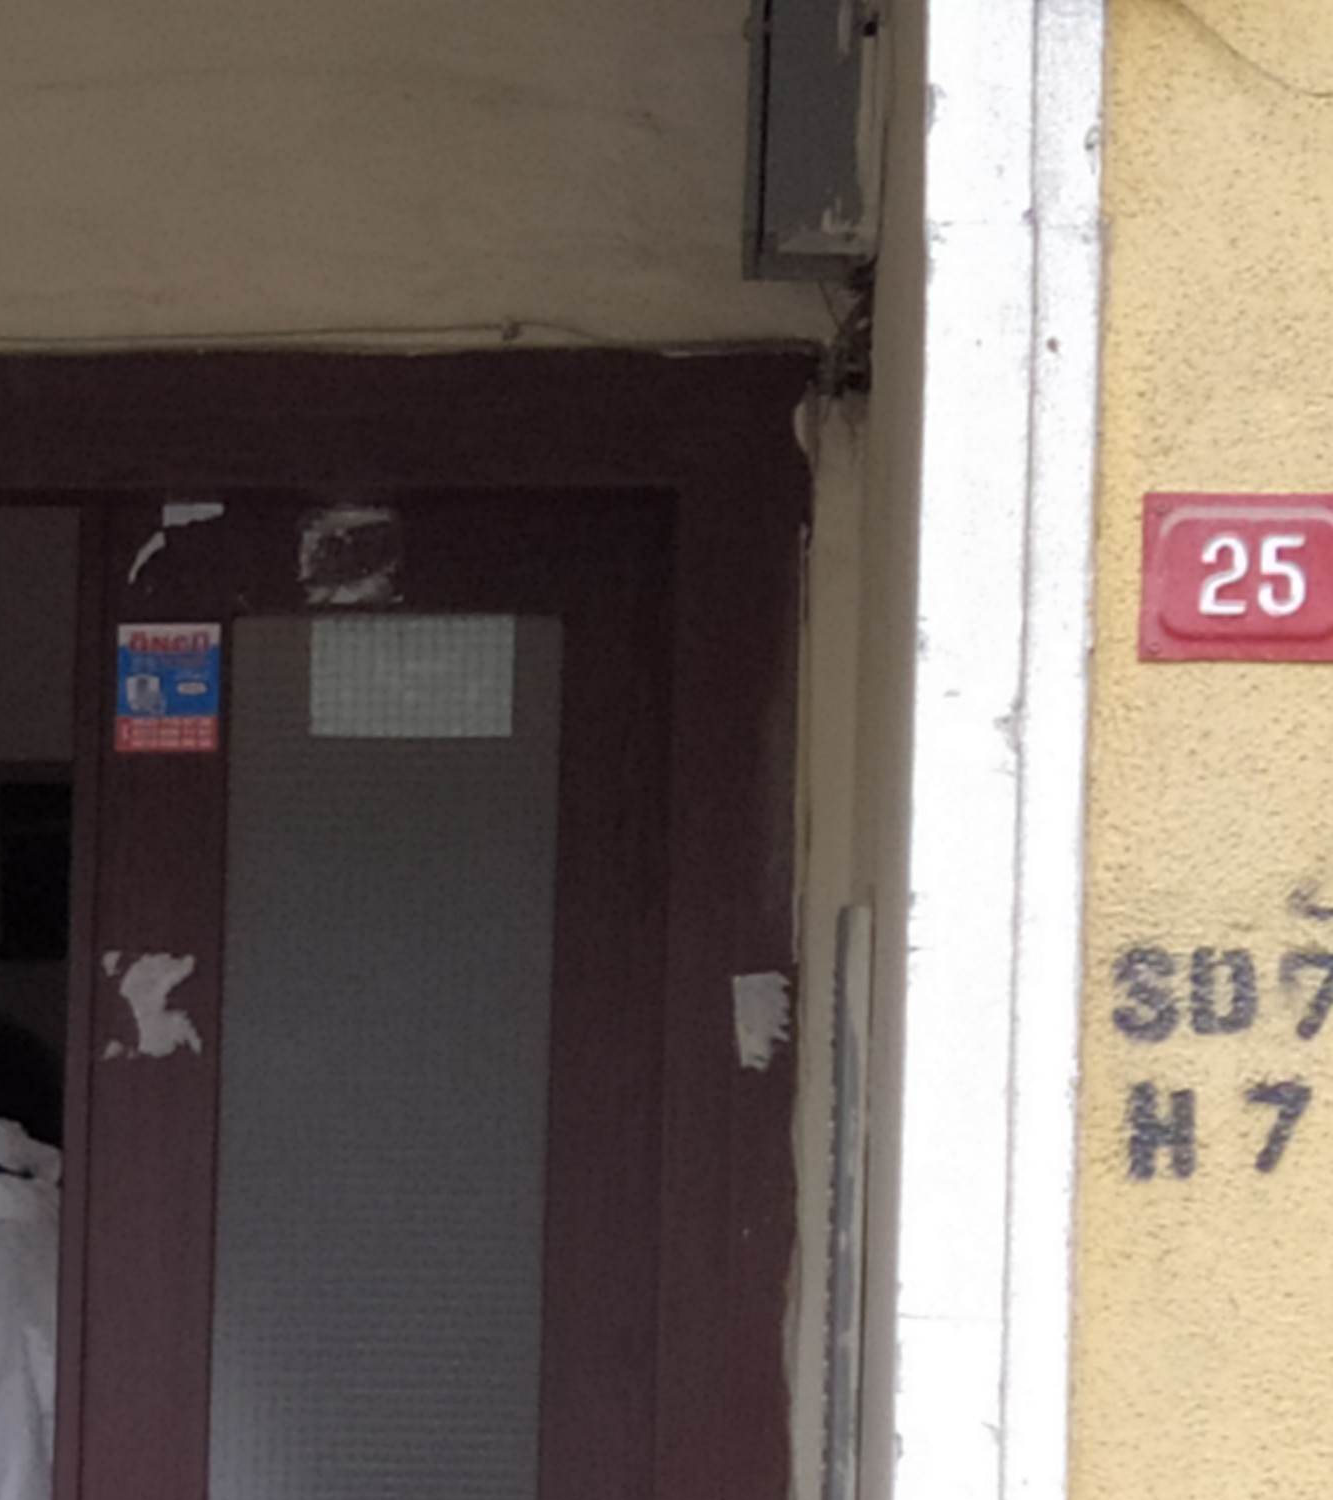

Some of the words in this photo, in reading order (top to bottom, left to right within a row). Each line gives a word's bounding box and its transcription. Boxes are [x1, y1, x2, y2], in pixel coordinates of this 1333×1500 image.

[1198, 533, 1307, 616] 25
[1125, 1080, 1197, 1180] H
[1243, 1076, 1313, 1173] 7
